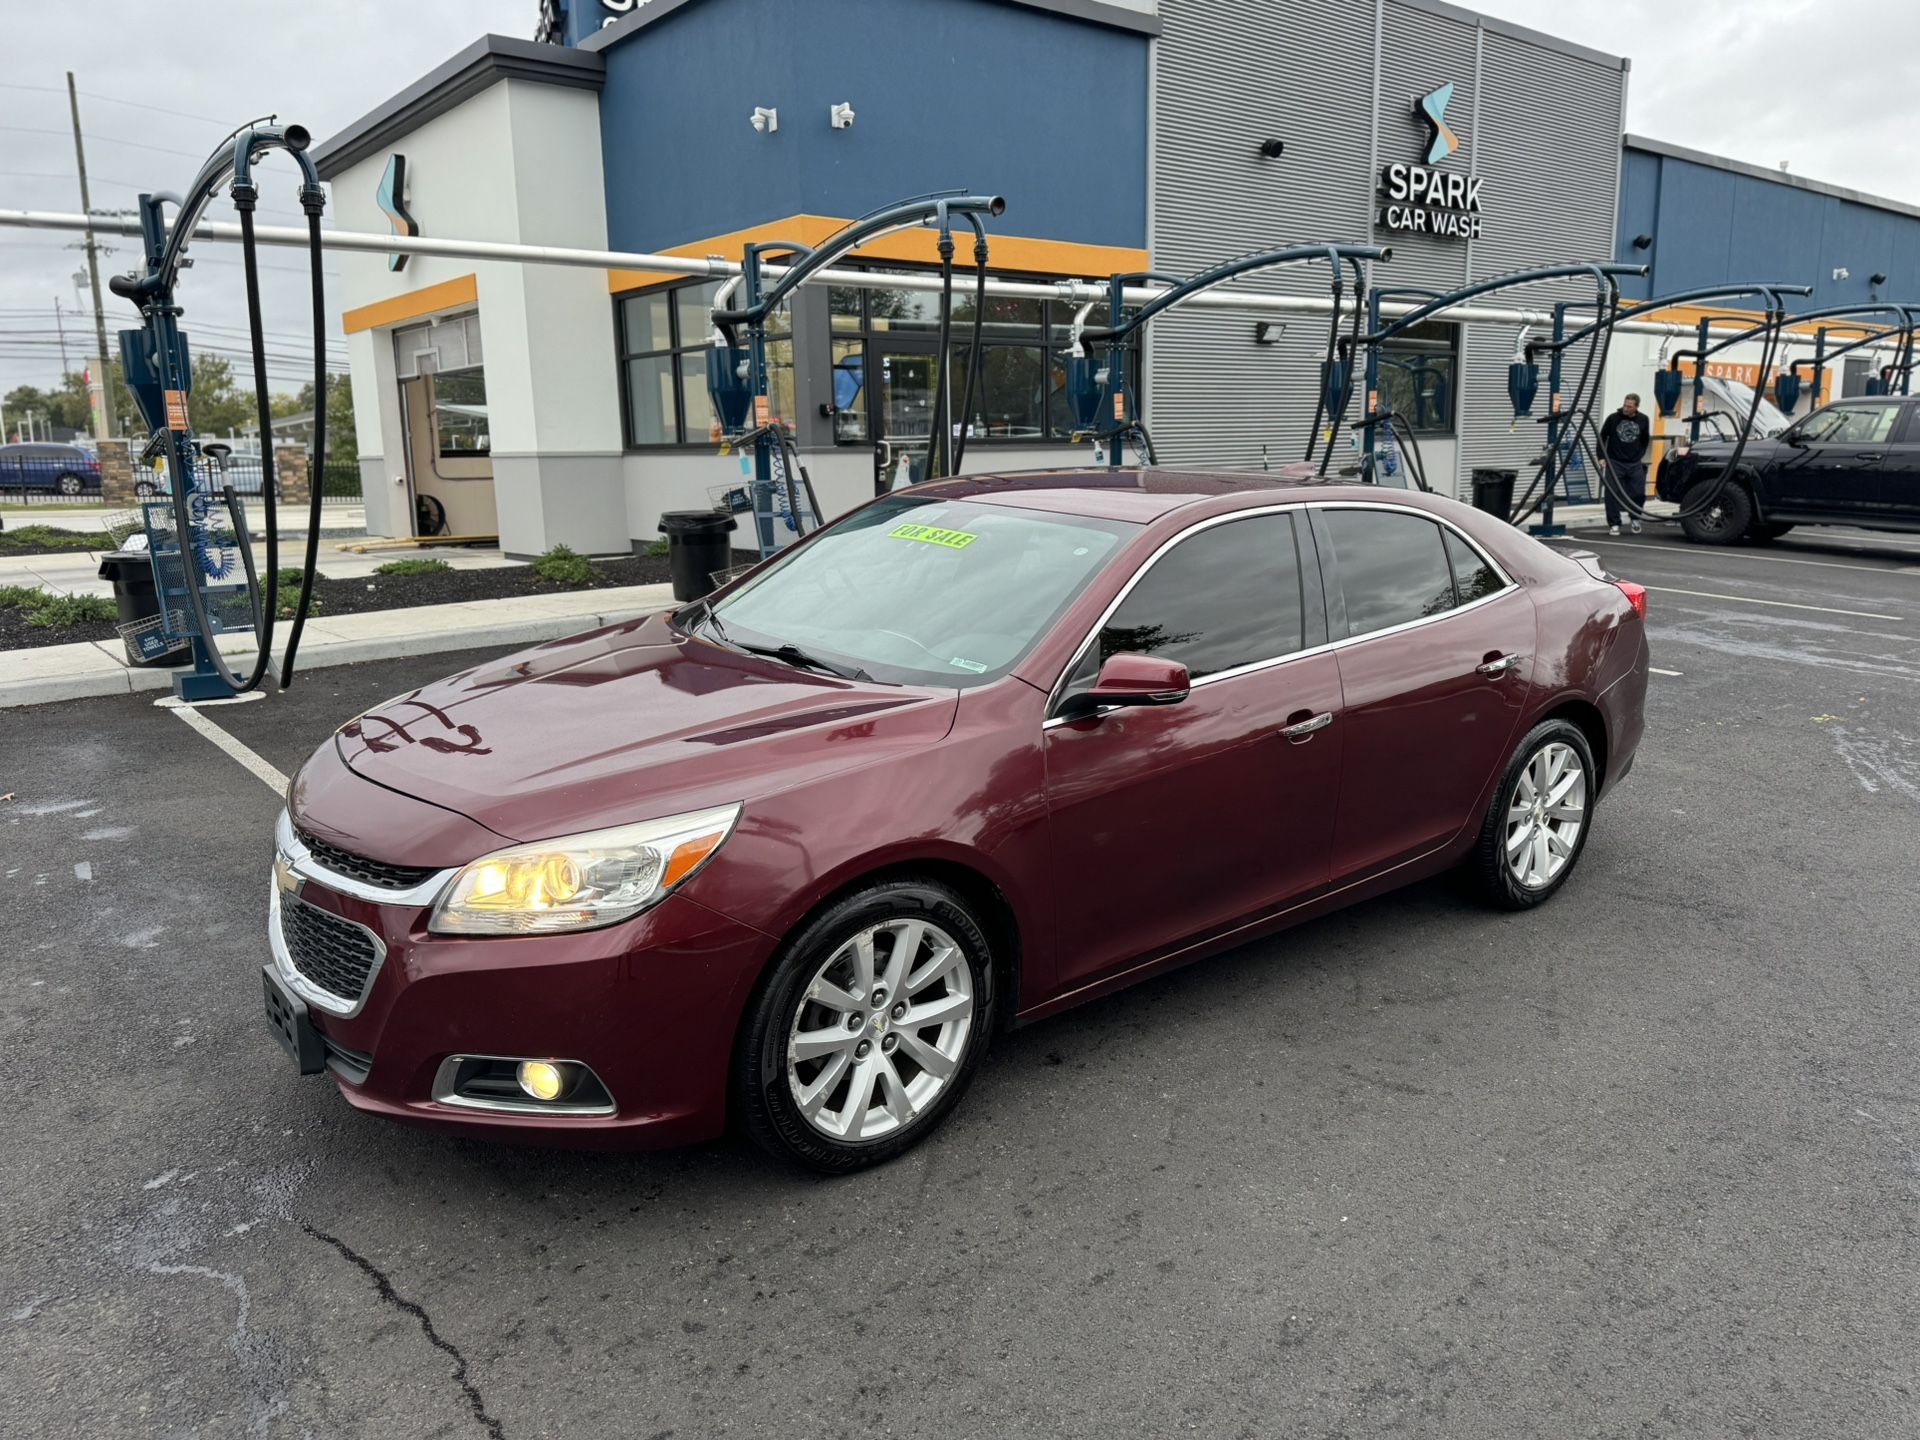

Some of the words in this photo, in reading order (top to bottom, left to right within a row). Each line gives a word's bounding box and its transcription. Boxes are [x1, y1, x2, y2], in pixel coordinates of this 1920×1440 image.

[1389, 163, 1484, 212] SPARK
[1387, 205, 1426, 232] CAR
[1431, 210, 1482, 239] WASH
[1706, 365, 1753, 384] SPARK
[892, 525, 929, 538] FOR
[926, 529, 974, 547] SALE
